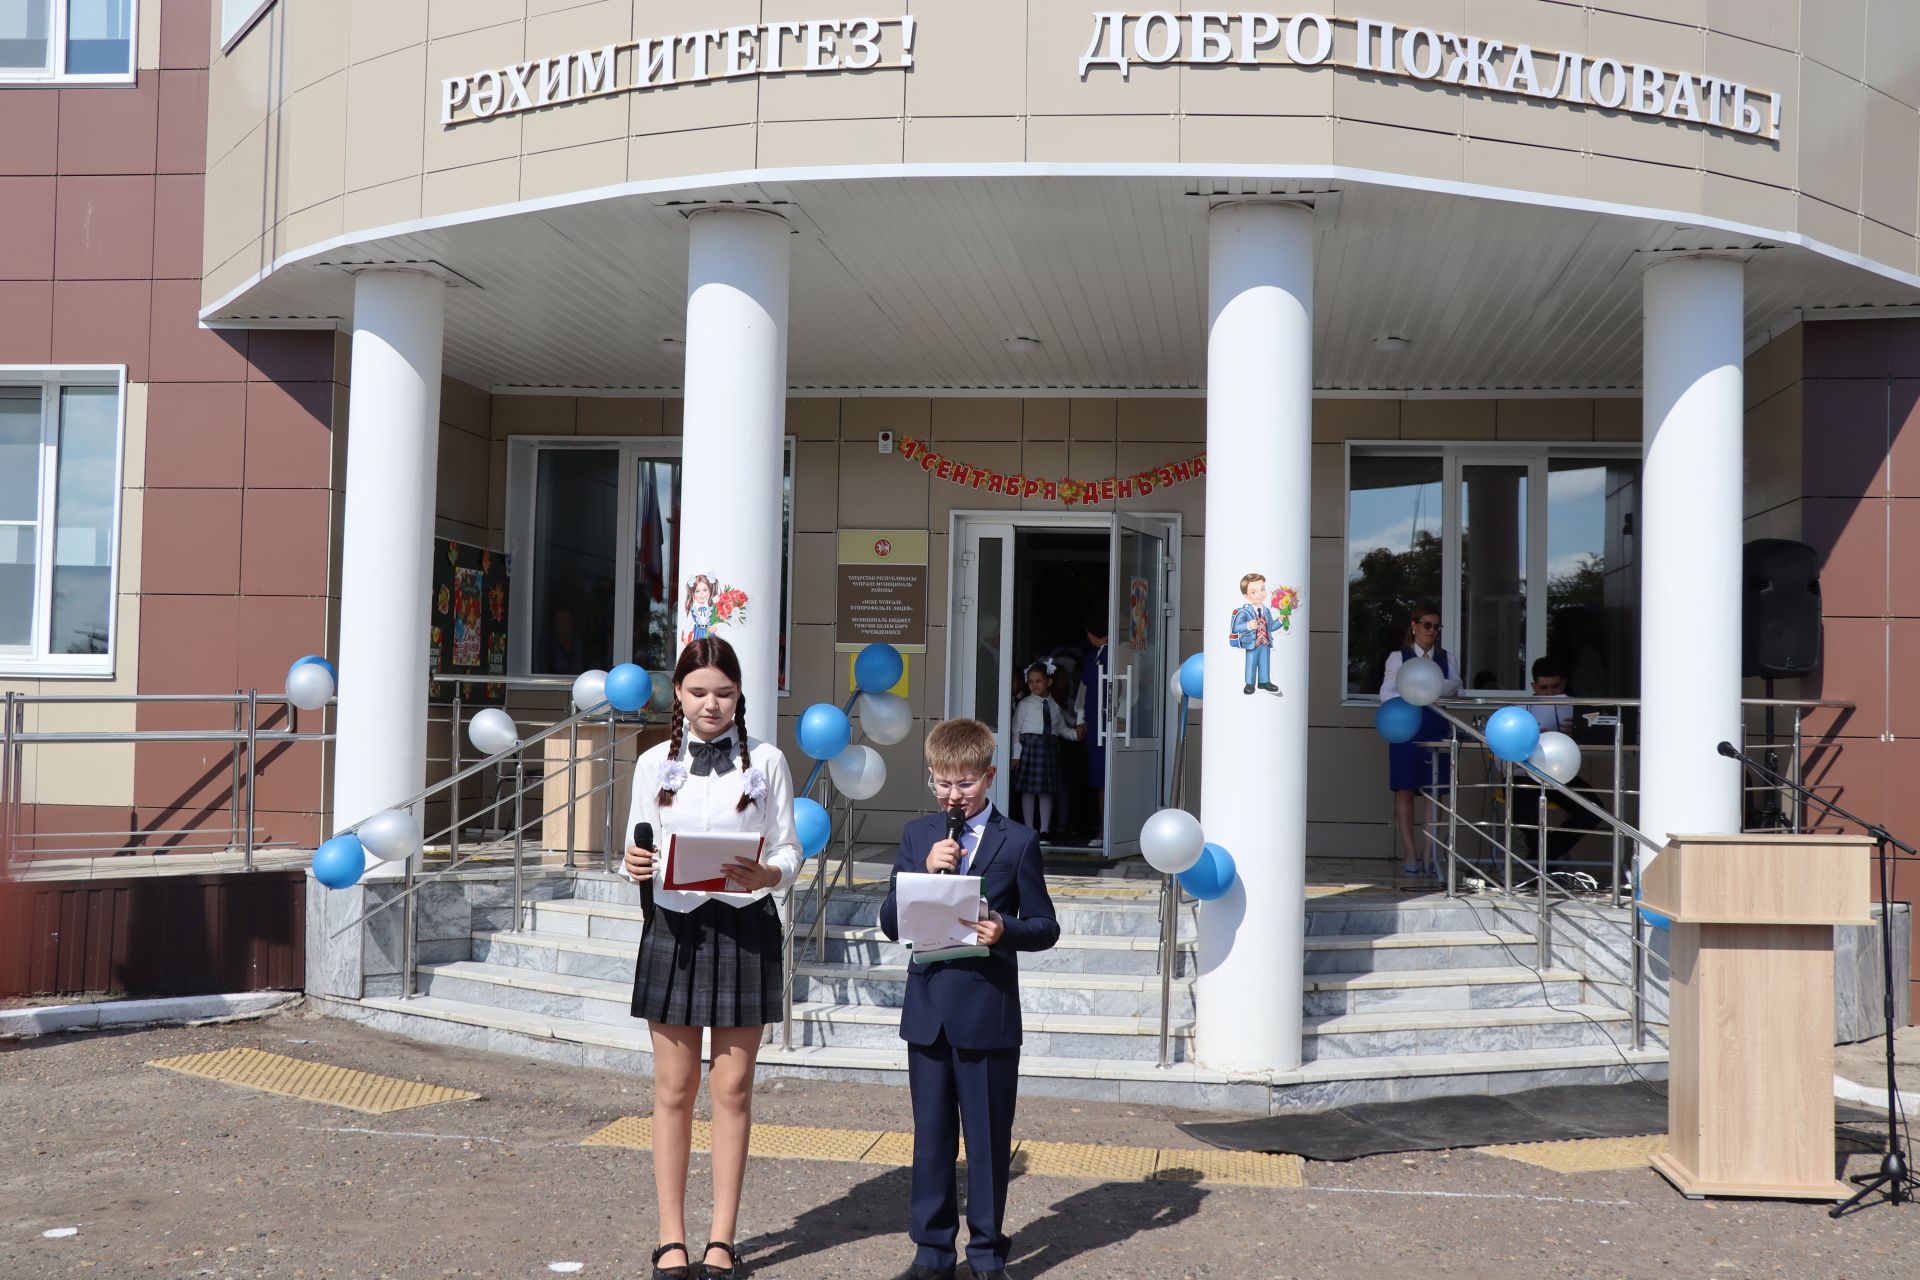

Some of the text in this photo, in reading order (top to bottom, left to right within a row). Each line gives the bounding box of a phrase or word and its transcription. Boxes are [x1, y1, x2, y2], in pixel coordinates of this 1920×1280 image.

[439, 43, 618, 125] РӘХИМ
[1078, 11, 1783, 141] ДОБРО ПОЖАЛОВАТЬ!
[904, 440, 919, 460] 1
[920, 452, 1058, 501] СЕНТЯБРЯ
[1082, 476, 1154, 505] ДЕНЬ
